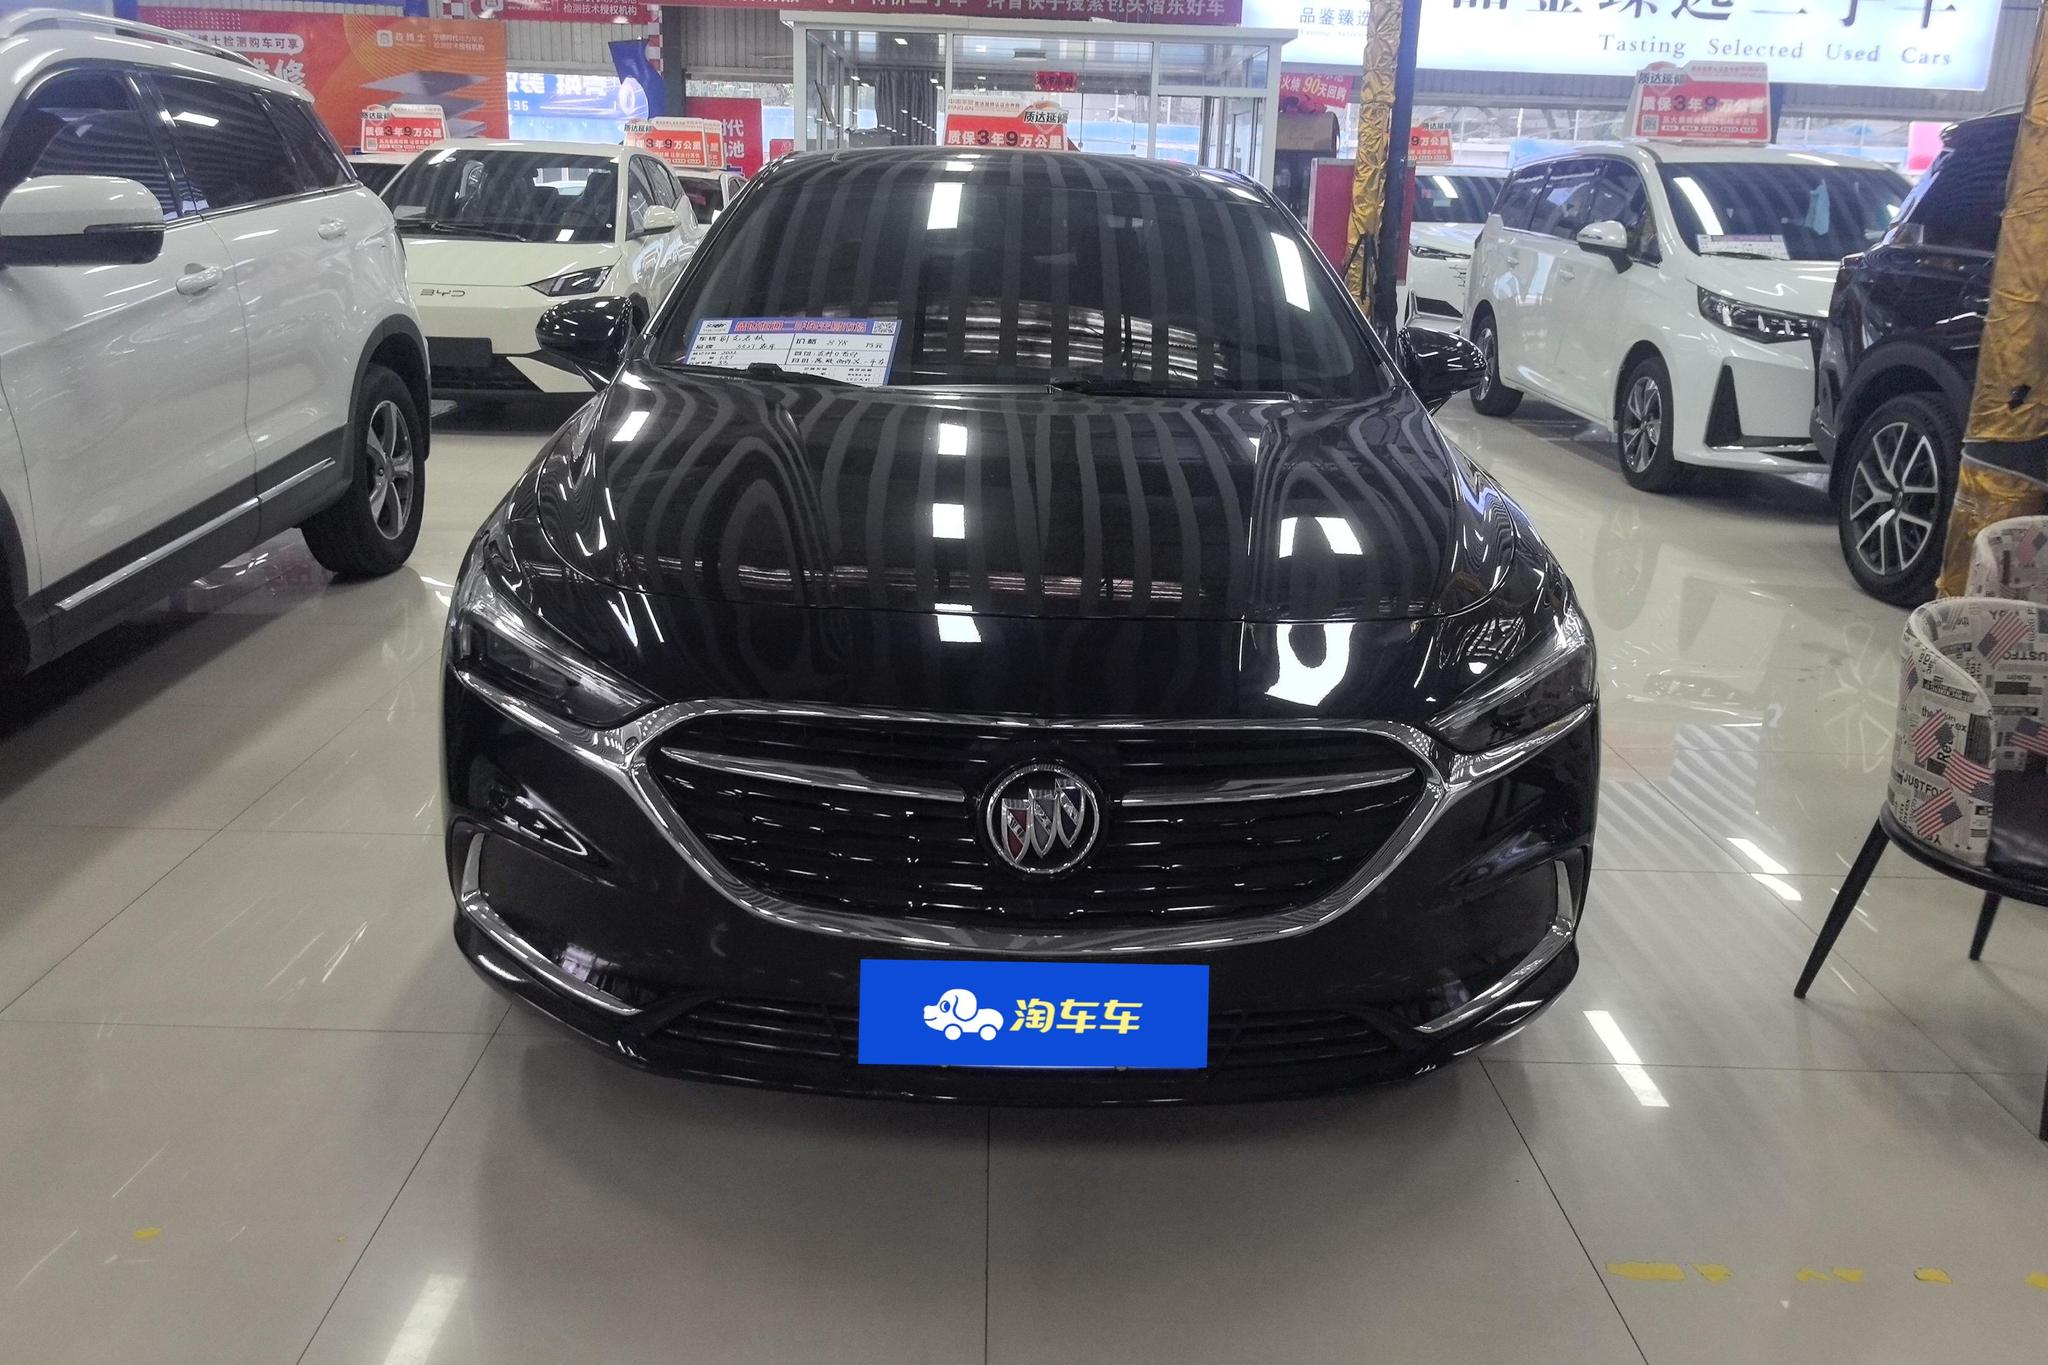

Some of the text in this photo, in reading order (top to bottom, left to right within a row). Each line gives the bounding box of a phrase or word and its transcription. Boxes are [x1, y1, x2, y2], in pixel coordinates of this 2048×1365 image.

[563, 3, 637, 15] 检测技术授权机构
[1599, 34, 1952, 65] Tasting Selected Used Cars
[1024, 110, 1069, 124] 质达延修
[947, 129, 1063, 149] 质保3年9万公里
[420, 288, 466, 298] BYD
